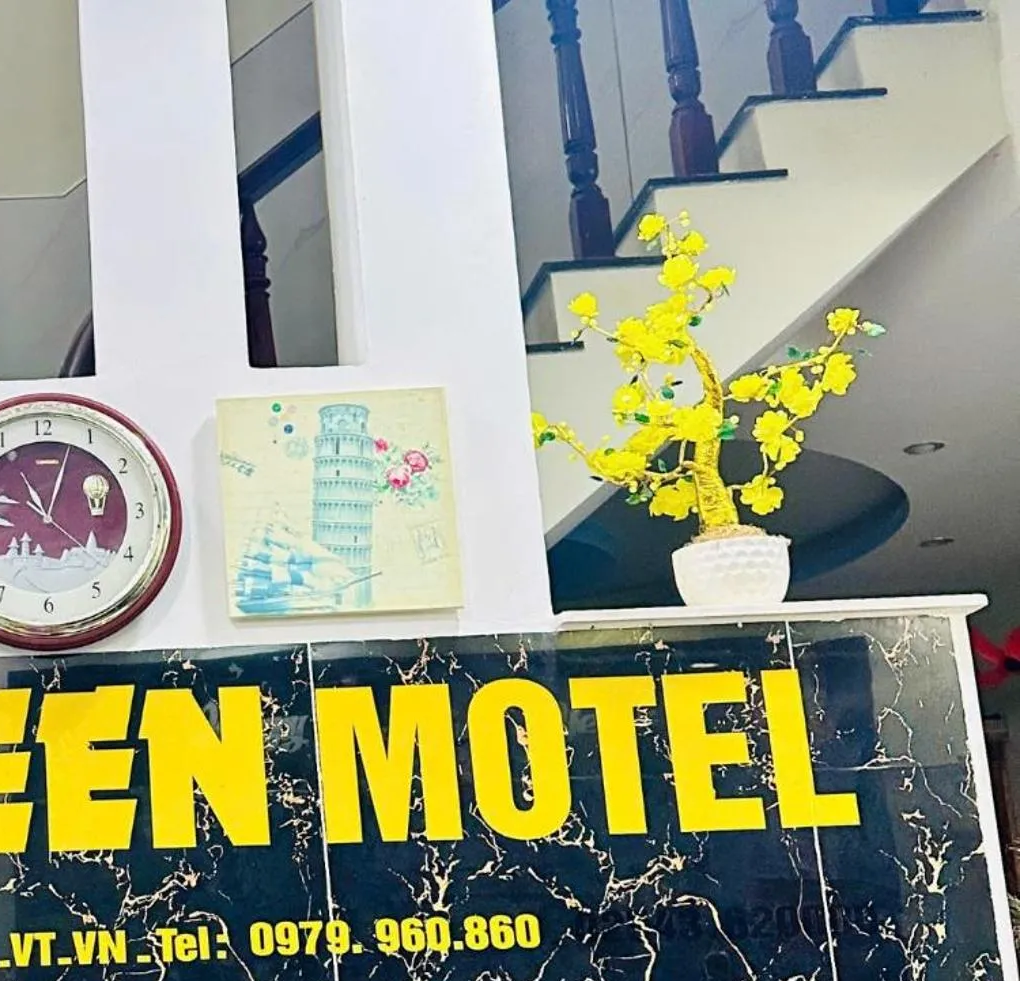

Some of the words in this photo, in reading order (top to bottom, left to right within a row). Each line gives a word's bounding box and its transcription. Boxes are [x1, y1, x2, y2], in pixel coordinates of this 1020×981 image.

[34, 420, 53, 436] 12
[87, 428, 93, 445] 1
[118, 457, 129, 474] 2
[135, 502, 145, 519] 3
[123, 546, 134, 562] 4
[91, 581, 101, 599] 5
[43, 596, 54, 614] 6
[315, 668, 860, 844] MOTEL
[375, 913, 542, 954] 960.860
